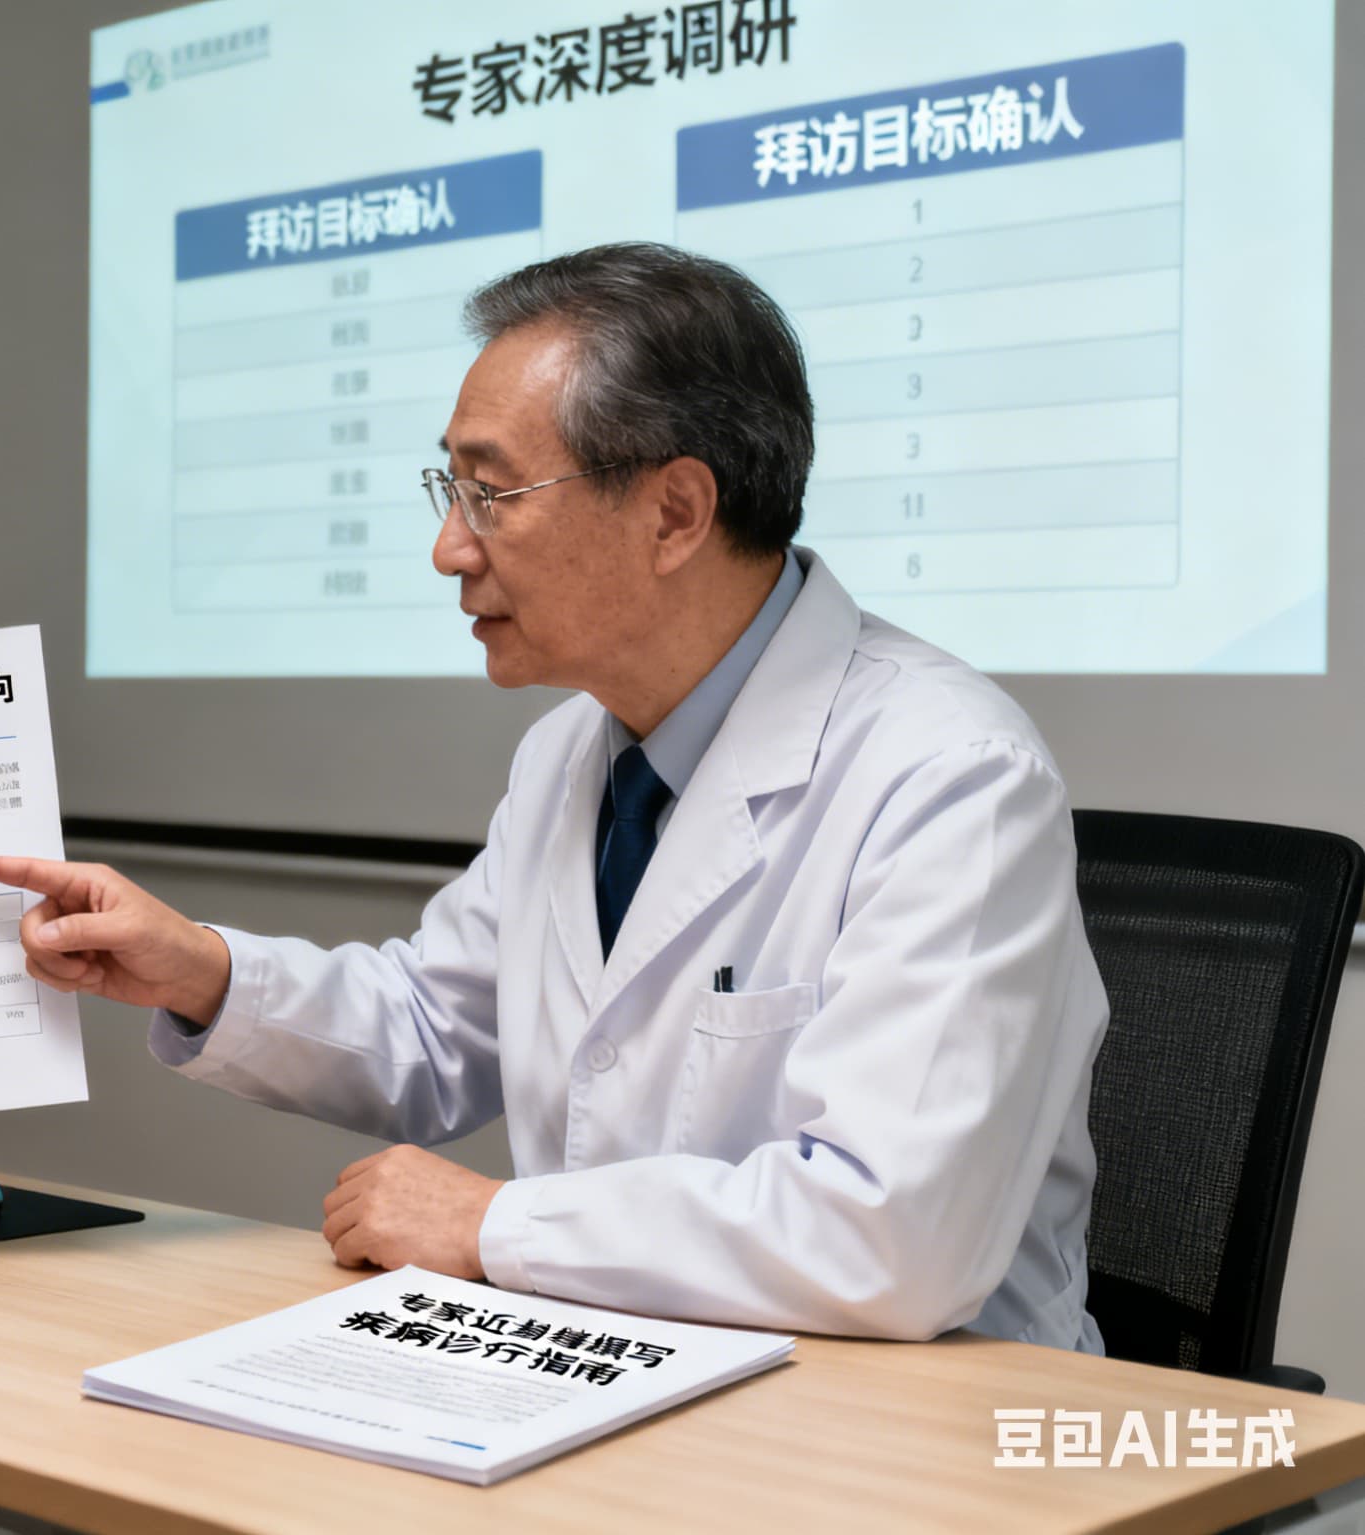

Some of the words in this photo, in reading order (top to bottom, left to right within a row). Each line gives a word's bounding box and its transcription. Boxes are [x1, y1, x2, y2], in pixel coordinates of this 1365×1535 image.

[413, 0, 797, 124] 专家深度调研
[752, 76, 1085, 188] 拜访目标确认
[246, 177, 456, 261] 拜访目标确认
[910, 256, 924, 283] 2
